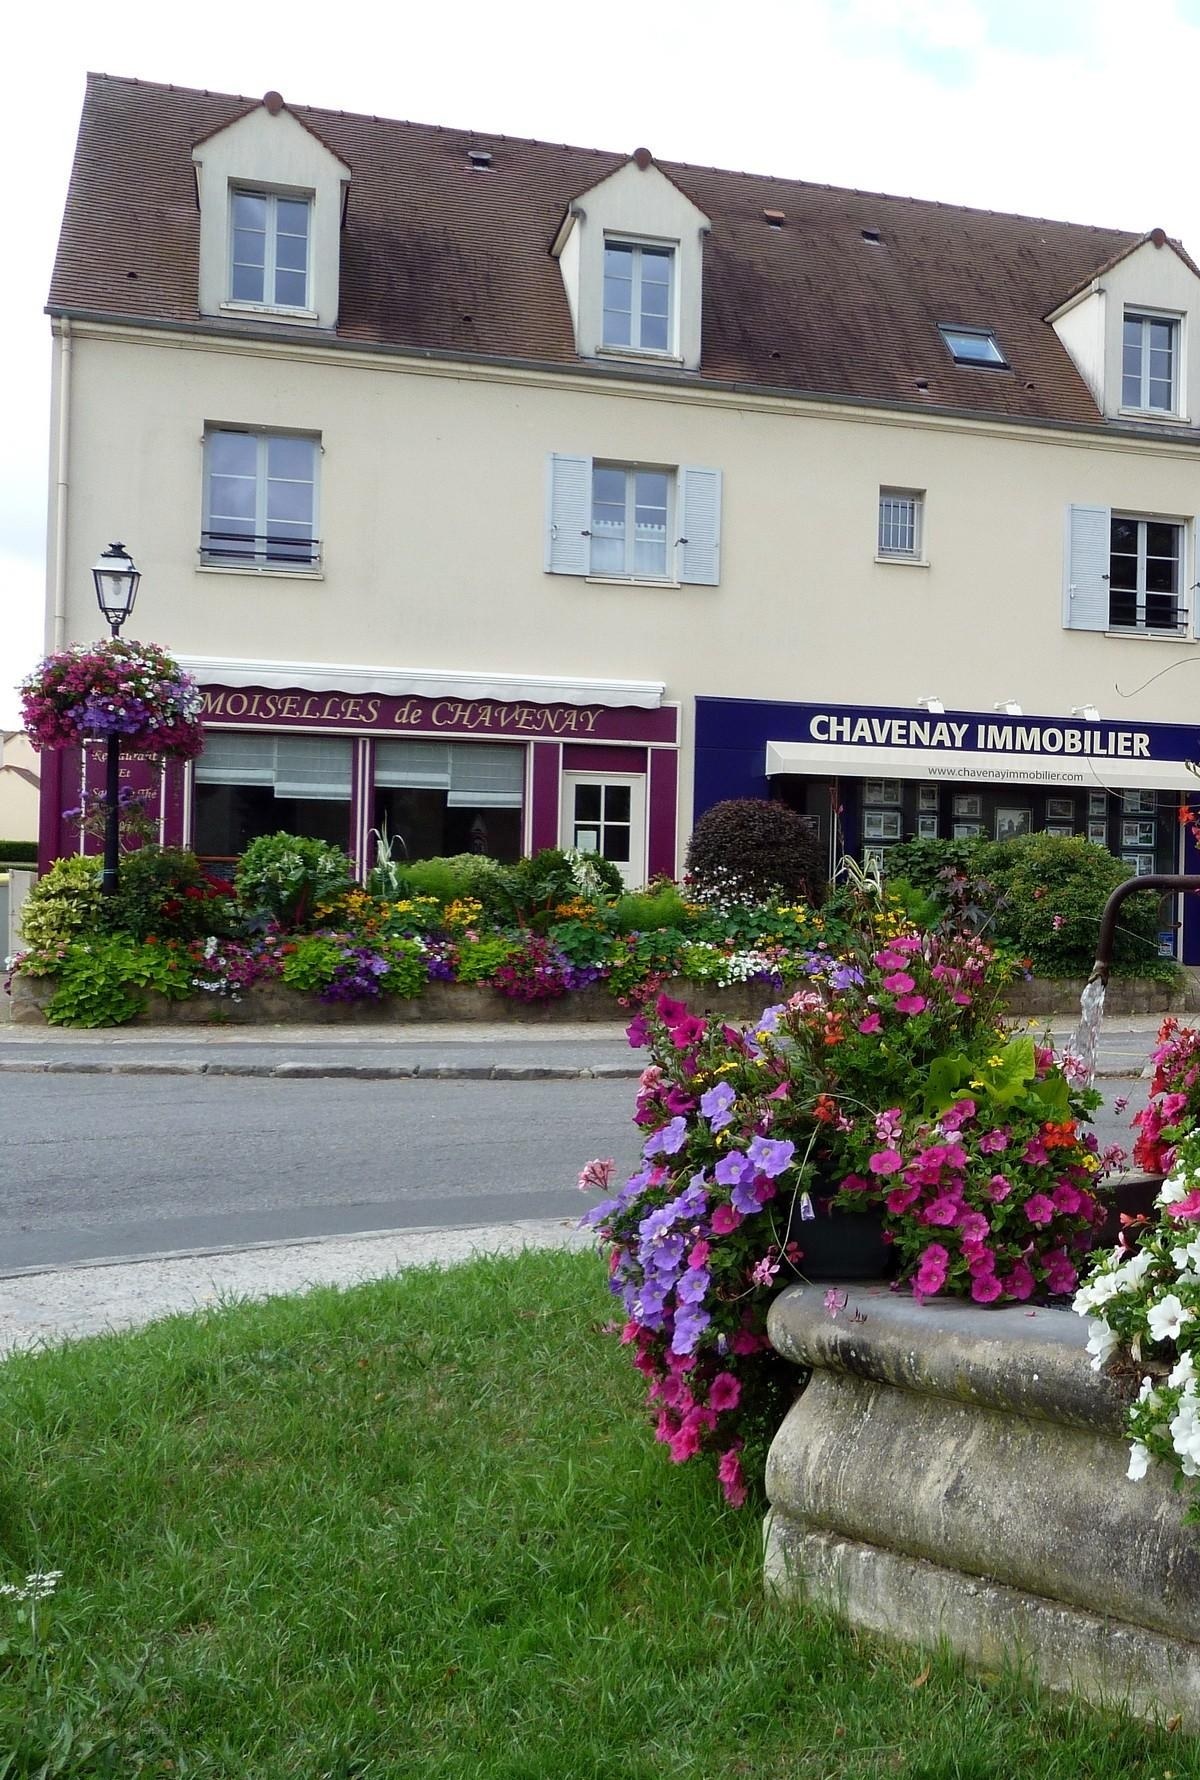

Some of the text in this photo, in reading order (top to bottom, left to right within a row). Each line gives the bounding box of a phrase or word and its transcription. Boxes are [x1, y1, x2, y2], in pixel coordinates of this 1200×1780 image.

[200, 692, 604, 733] MOISELLES de CHAVENAY
[809, 715, 1151, 757] CHAVENAY IMMOBILIER
[91, 750, 158, 762] Reaurant
[928, 767, 1084, 783] www.chavenayimmobilier.com
